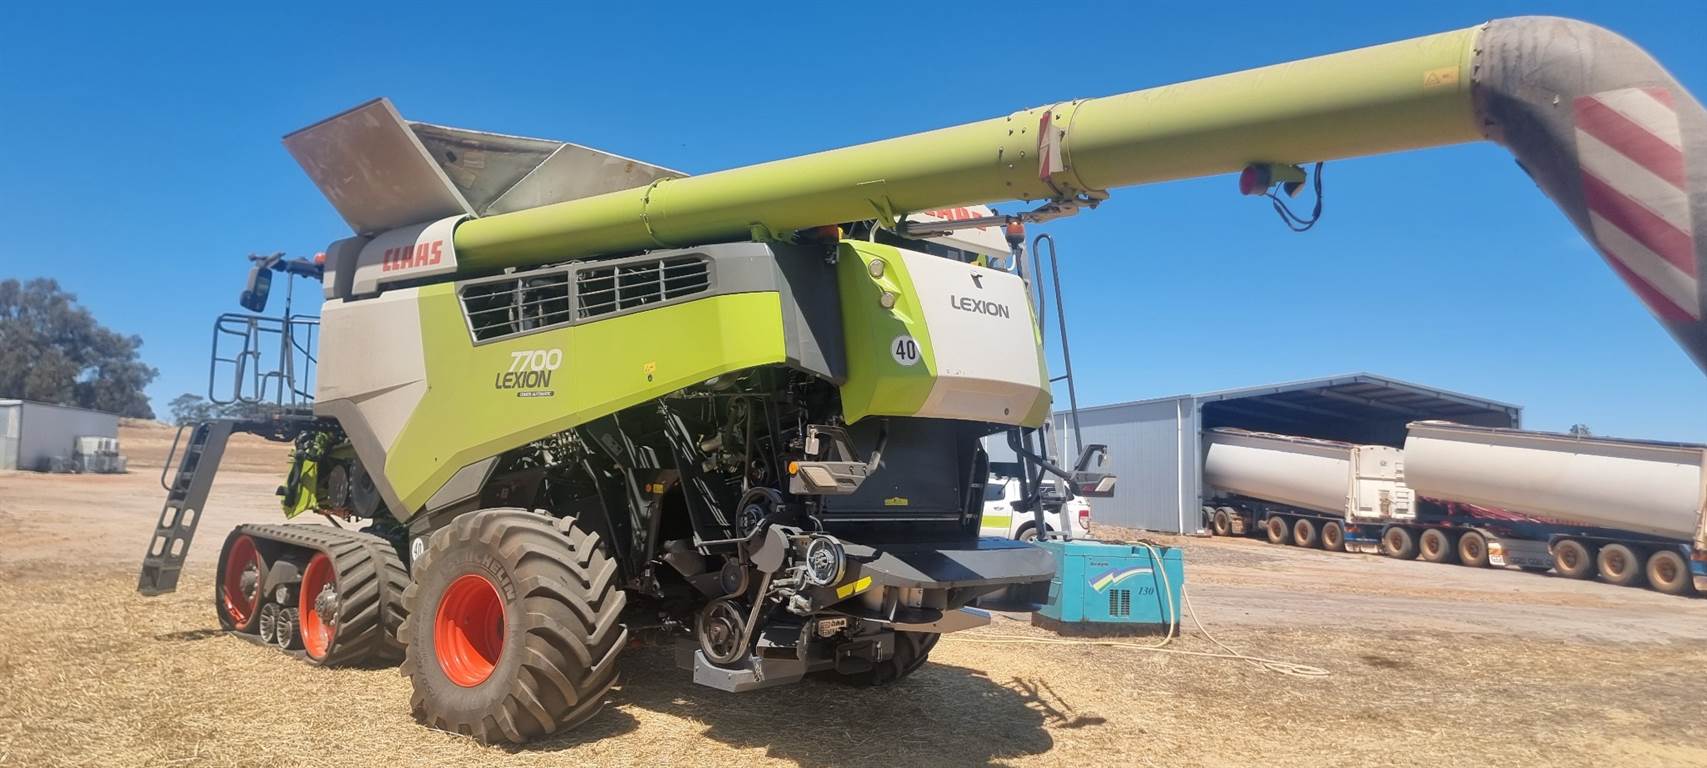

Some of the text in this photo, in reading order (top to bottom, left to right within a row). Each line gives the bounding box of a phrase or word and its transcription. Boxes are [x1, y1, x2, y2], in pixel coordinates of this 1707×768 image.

[382, 240, 443, 272] CLAAS
[950, 295, 1010, 319] LEXION
[508, 348, 562, 372] 7700
[896, 340, 916, 360] 40
[495, 370, 552, 389] LEXION
[1138, 586, 1154, 596] 130
